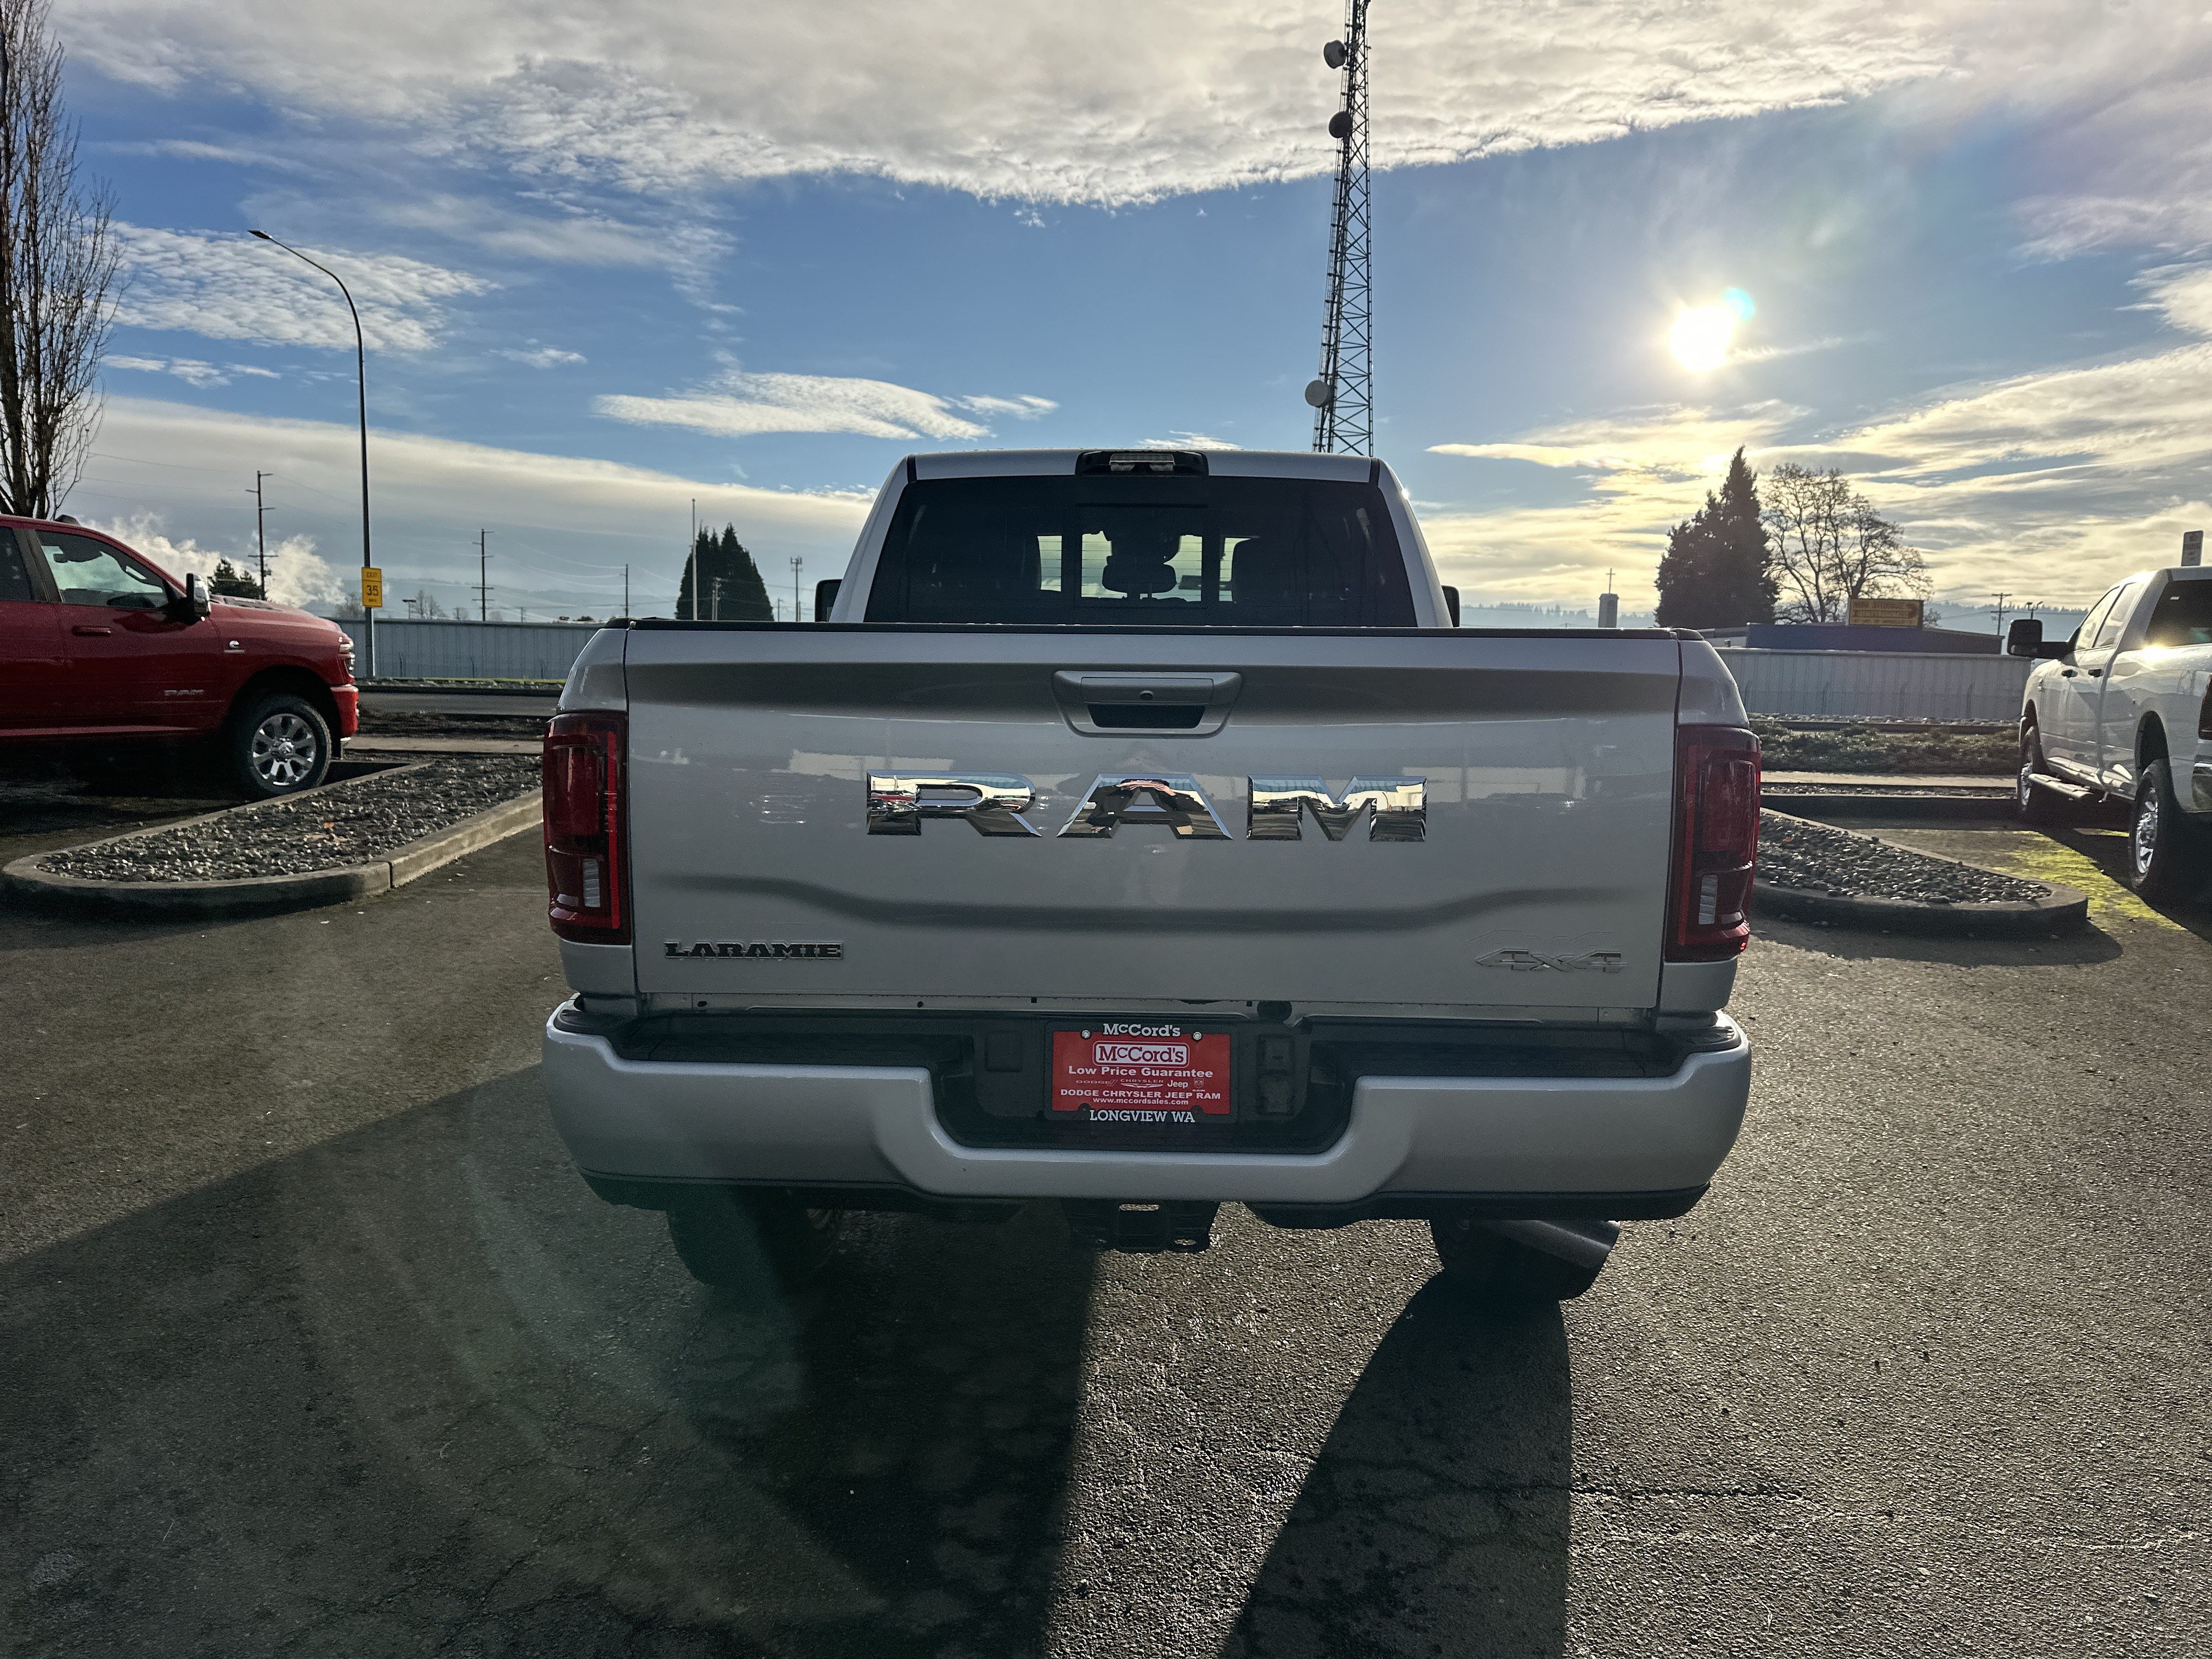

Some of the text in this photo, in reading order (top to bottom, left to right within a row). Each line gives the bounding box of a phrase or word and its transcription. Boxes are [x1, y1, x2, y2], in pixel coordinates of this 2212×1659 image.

[366, 585, 379, 596] 35
[867, 770, 1427, 842] RAM
[663, 940, 844, 960] LARAMIE
[1103, 1023, 1181, 1037] McCord's
[1098, 1046, 1184, 1063] McCord's
[1069, 1065, 1213, 1077] Low Price Guarantee
[1167, 1080, 1188, 1088] Jeep
[1090, 1109, 1195, 1123] LONGVIEW WA
